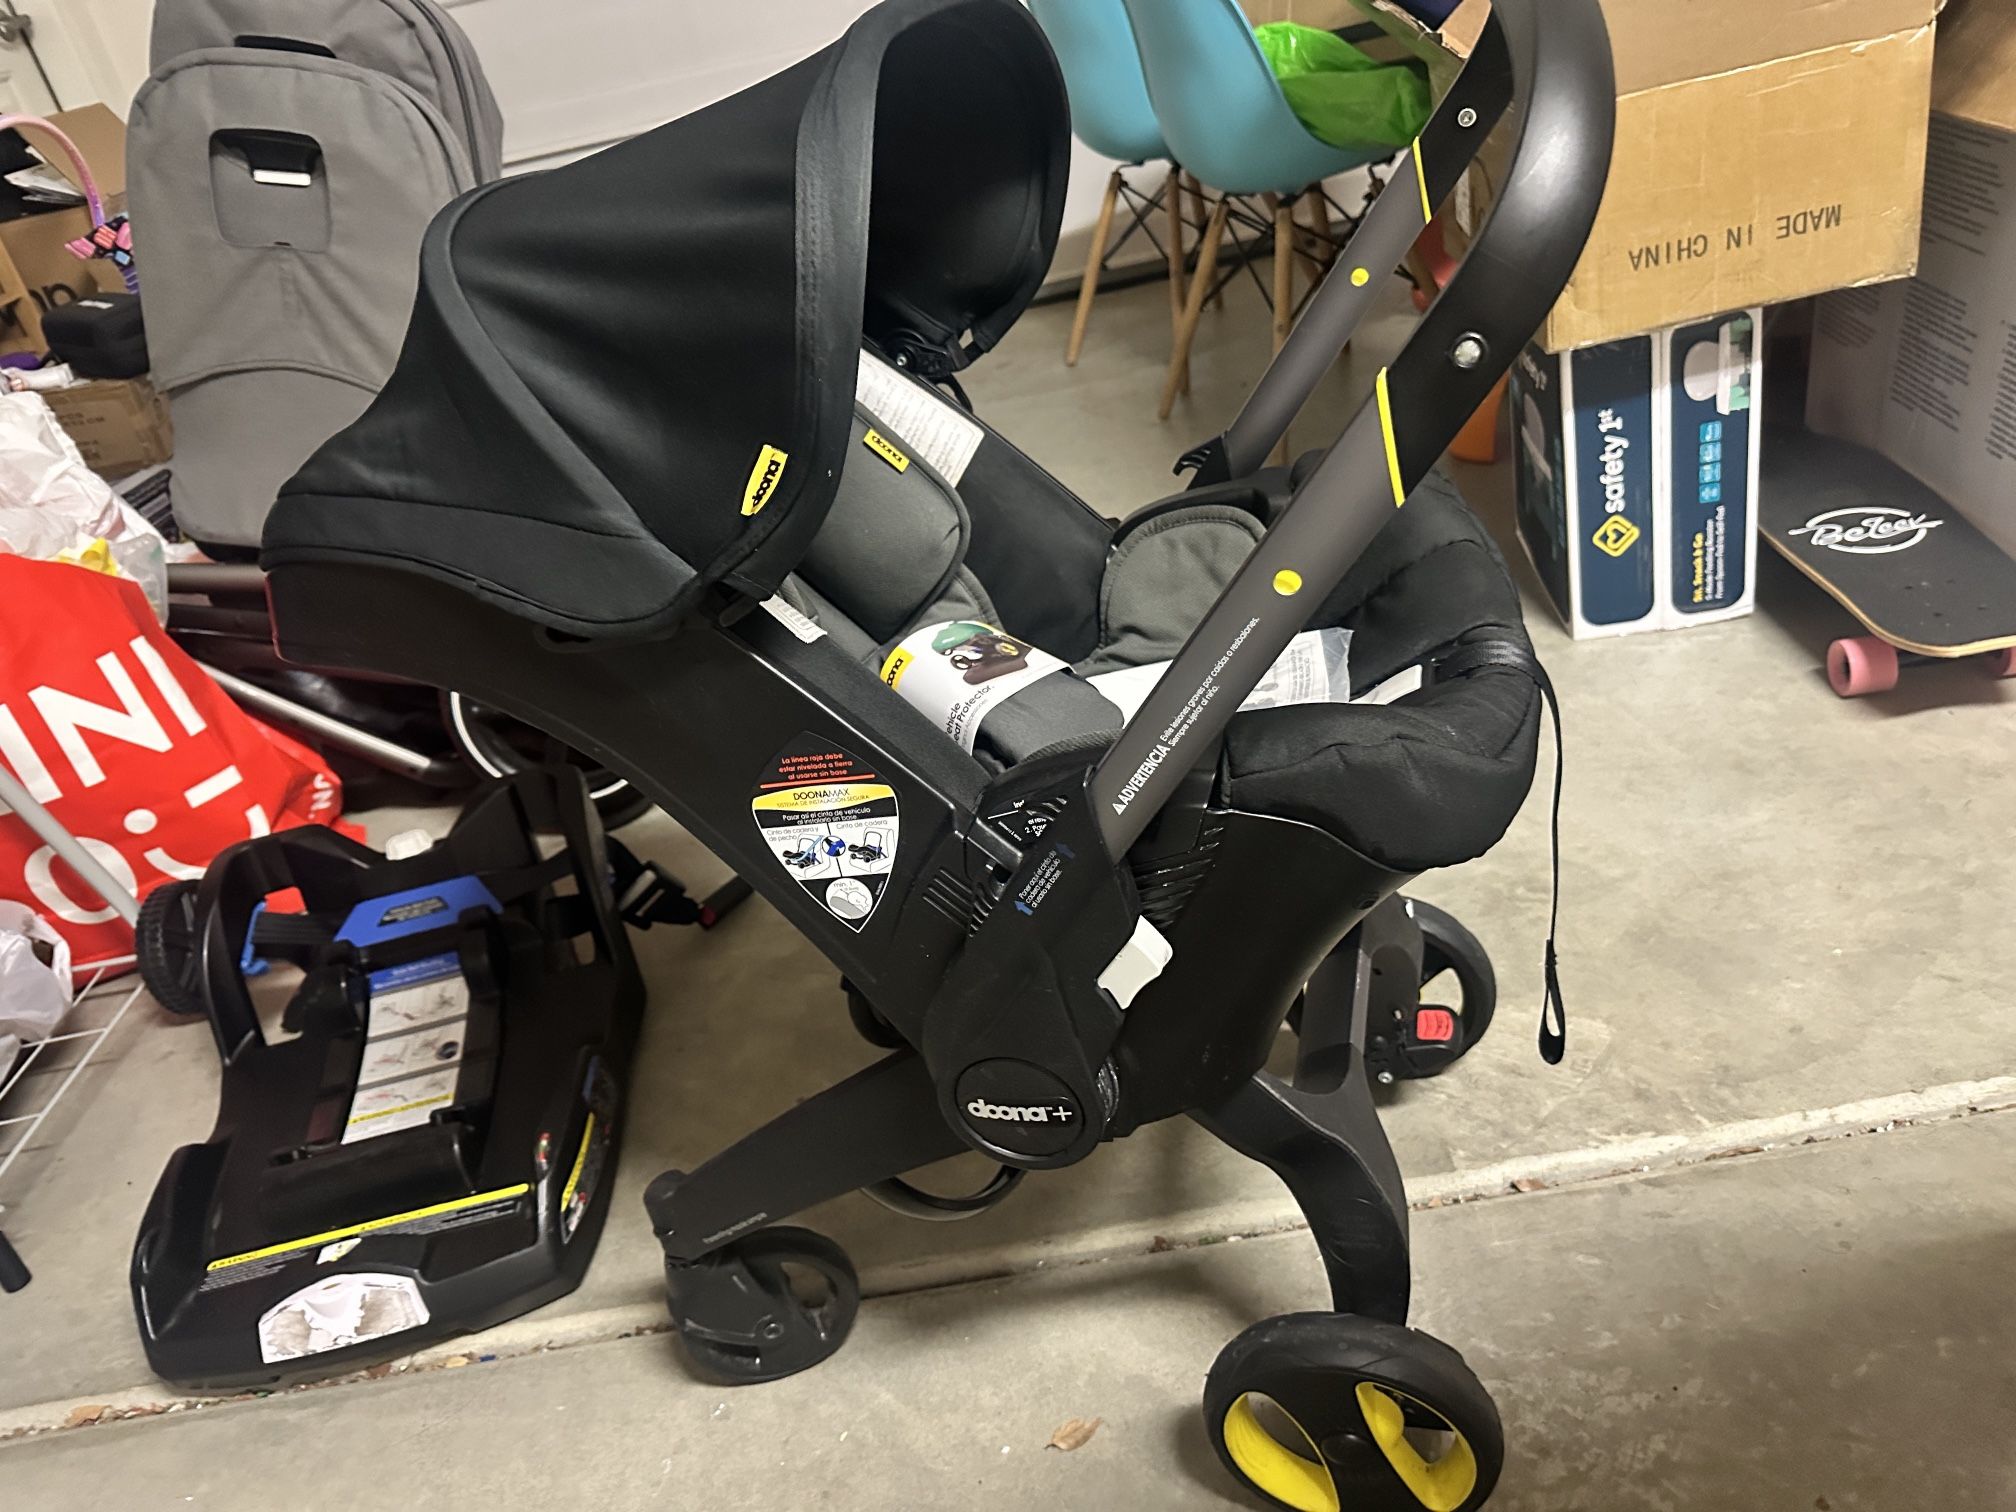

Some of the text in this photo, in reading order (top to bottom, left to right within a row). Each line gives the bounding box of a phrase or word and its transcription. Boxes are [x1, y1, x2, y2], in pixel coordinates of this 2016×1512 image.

[1628, 204, 1842, 272] MADE IN CHINA
[872, 435, 902, 462] doona
[1598, 408, 1629, 513] safety 1st
[752, 460, 781, 507] doona
[887, 659, 903, 686] oona
[1161, 727, 1173, 741] Evite
[1170, 705, 1190, 729] lesiones
[1189, 687, 1206, 707] graves
[1203, 676, 1214, 688] por
[1210, 656, 1228, 677] caídas
[1230, 616, 1259, 651] resbalones.
[0, 635, 207, 814] INI
[945, 702, 961, 735] ehicle
[953, 718, 963, 744] eat
[1118, 744, 1171, 806] ADVERTENCIA
[1169, 723, 1189, 747] Siempre
[1186, 705, 1203, 725] sujetar
[1205, 683, 1219, 699] niño.
[793, 788, 850, 800] DOONAMAX
[1019, 884, 1031, 898] Poner
[1025, 885, 1040, 903] cadera
[1038, 878, 1045, 886] de
